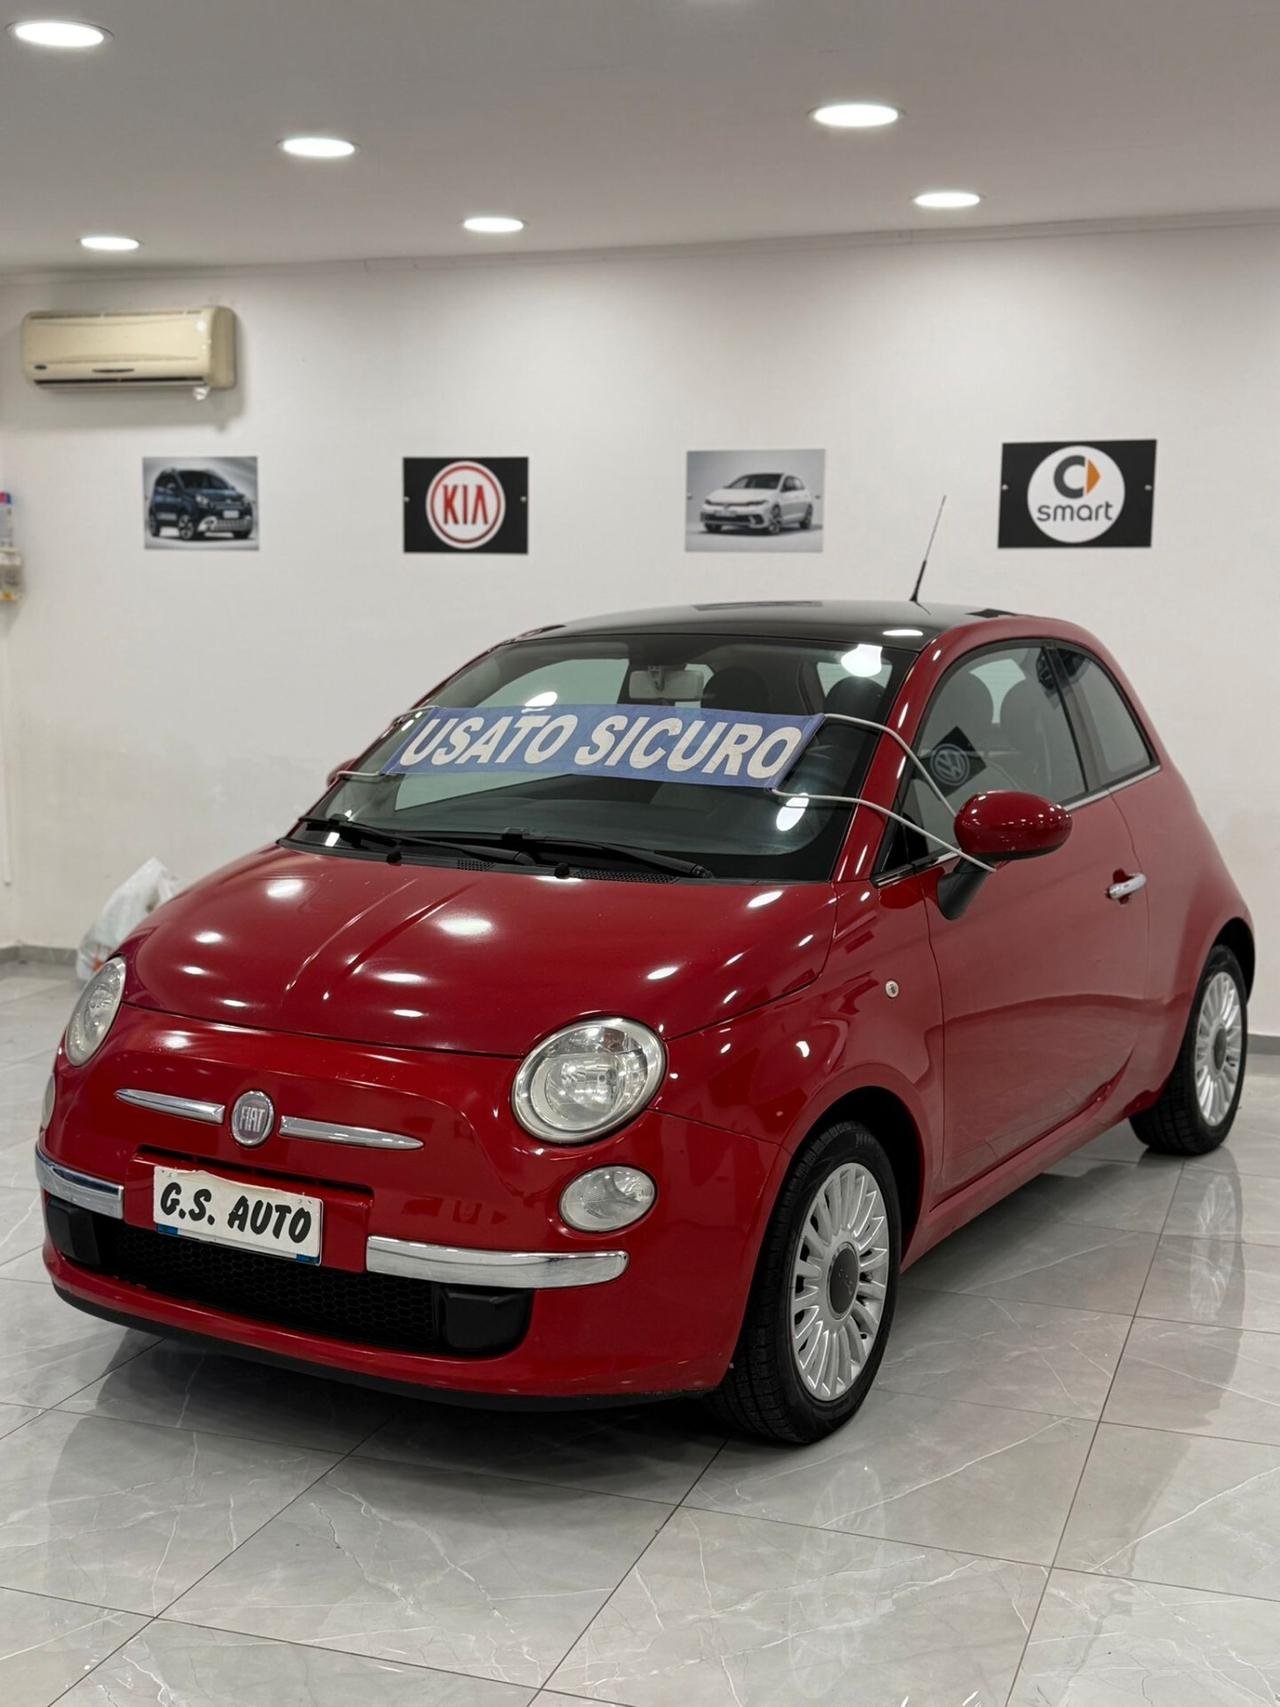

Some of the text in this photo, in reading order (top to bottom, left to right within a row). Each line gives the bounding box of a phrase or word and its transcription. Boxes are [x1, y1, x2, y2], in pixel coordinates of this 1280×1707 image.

[443, 484, 489, 526] KIA
[1037, 501, 1113, 522] smart
[400, 714, 802, 779] USATO SICURO
[240, 1106, 265, 1132] FIAT
[160, 1182, 312, 1243] G.S. AUTO
